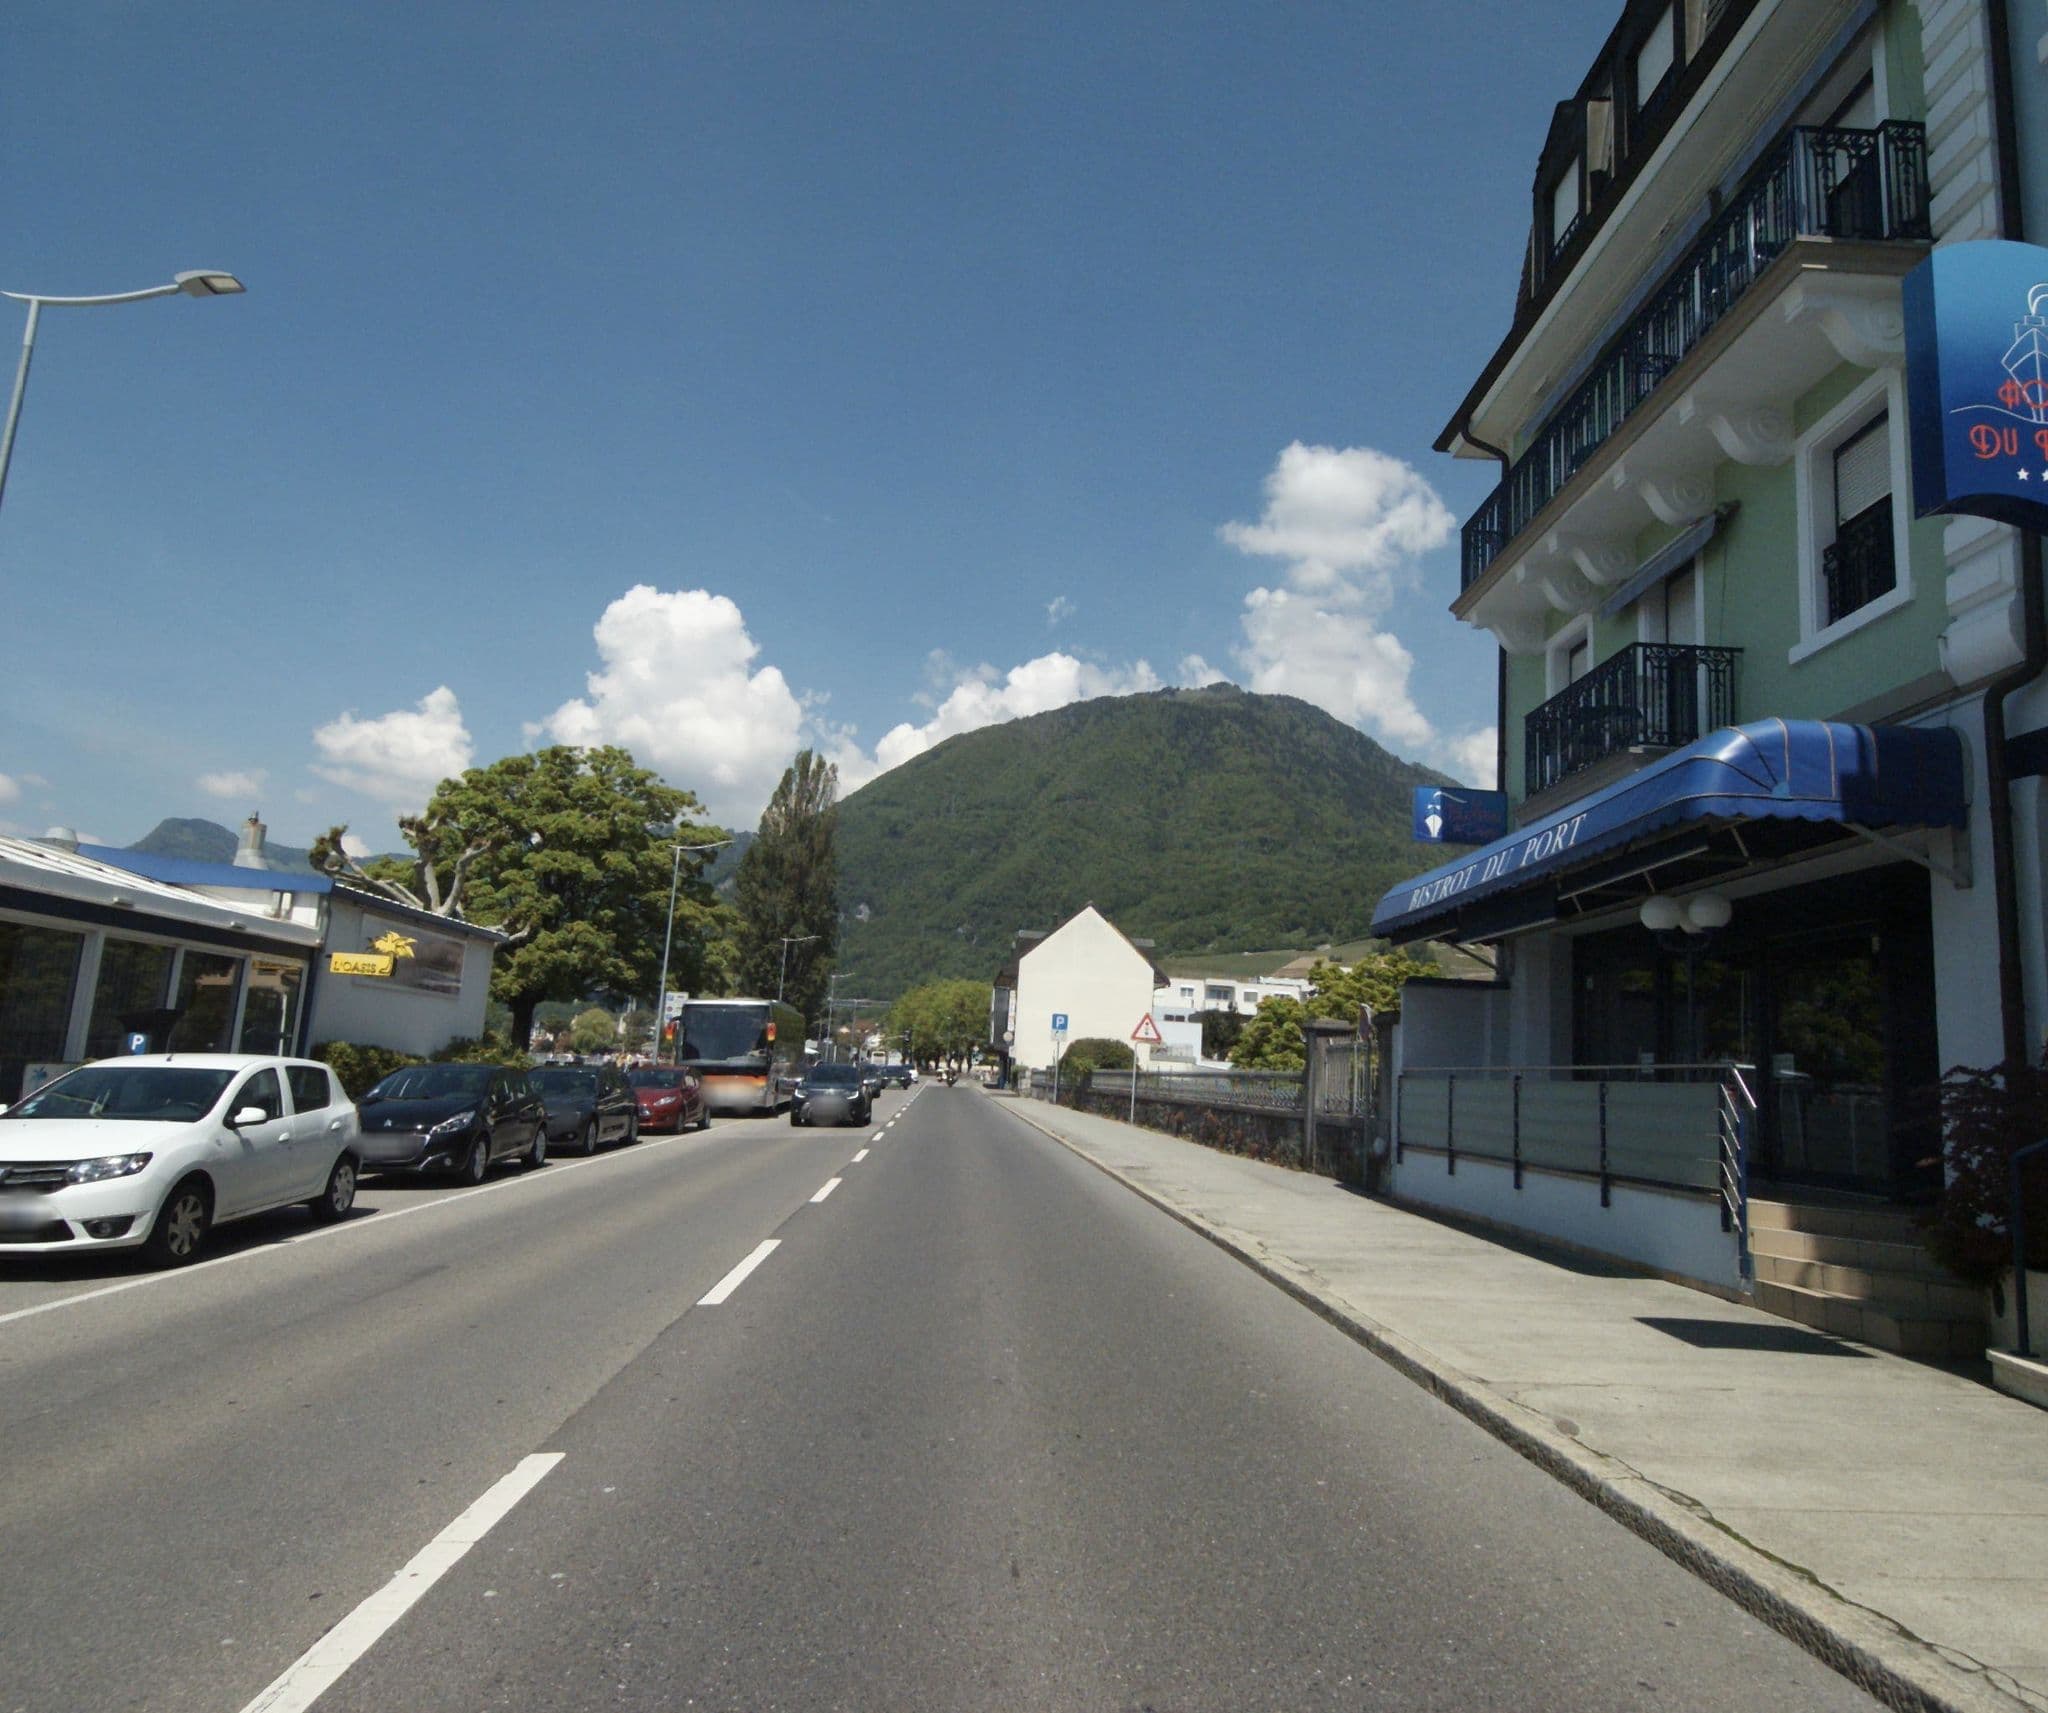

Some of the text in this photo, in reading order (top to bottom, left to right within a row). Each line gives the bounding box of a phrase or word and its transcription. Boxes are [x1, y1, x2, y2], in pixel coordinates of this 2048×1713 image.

[1970, 424, 2018, 460] DU
[1408, 864, 1477, 912] BISTROT
[1482, 847, 1514, 882] DU
[1520, 813, 1587, 867] PORT
[333, 960, 377, 974] L'OASIS
[1056, 1015, 1065, 1028] P
[131, 1034, 144, 1050] P
